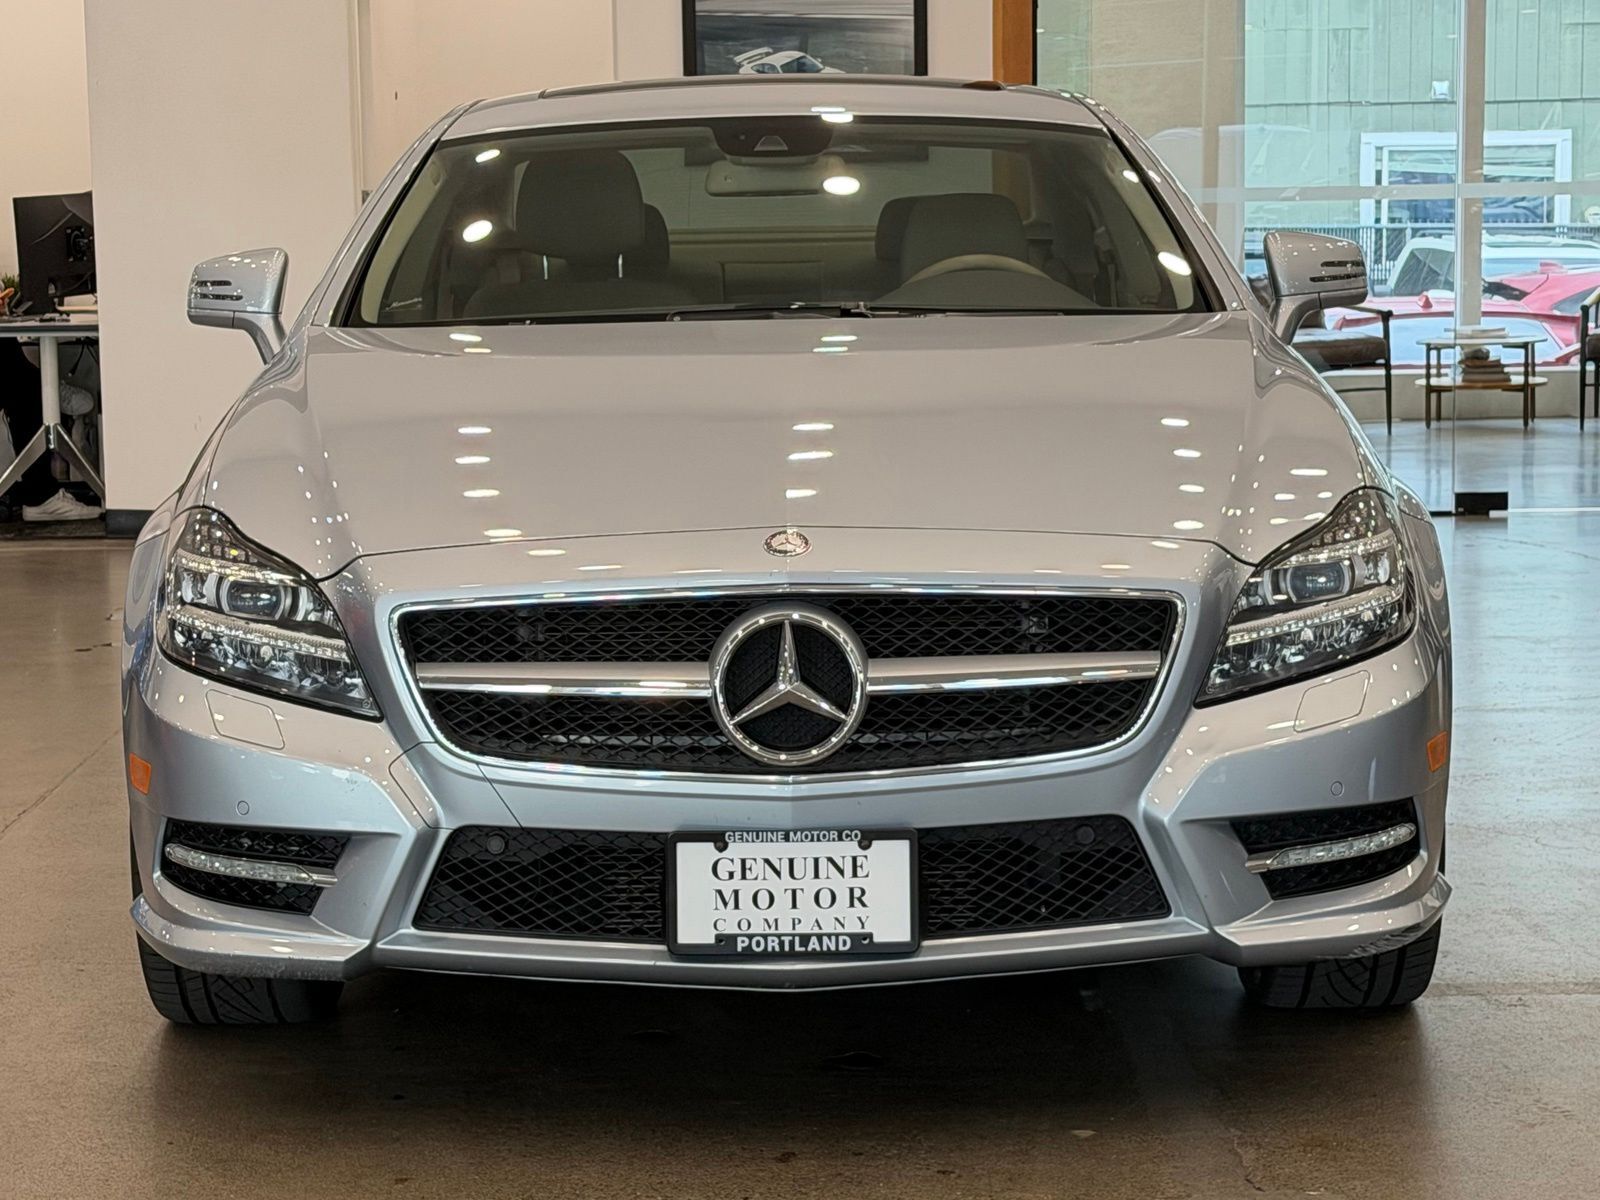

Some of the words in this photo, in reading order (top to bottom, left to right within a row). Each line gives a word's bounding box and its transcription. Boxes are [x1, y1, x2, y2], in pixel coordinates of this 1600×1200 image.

[725, 831, 786, 843] GENUINE
[789, 831, 838, 842] MOTOR
[842, 830, 861, 841] CO
[711, 855, 870, 881] GENUINE
[713, 886, 869, 911] MOTOR
[713, 916, 870, 932] COMPANY
[736, 935, 852, 952] PORTLAND
